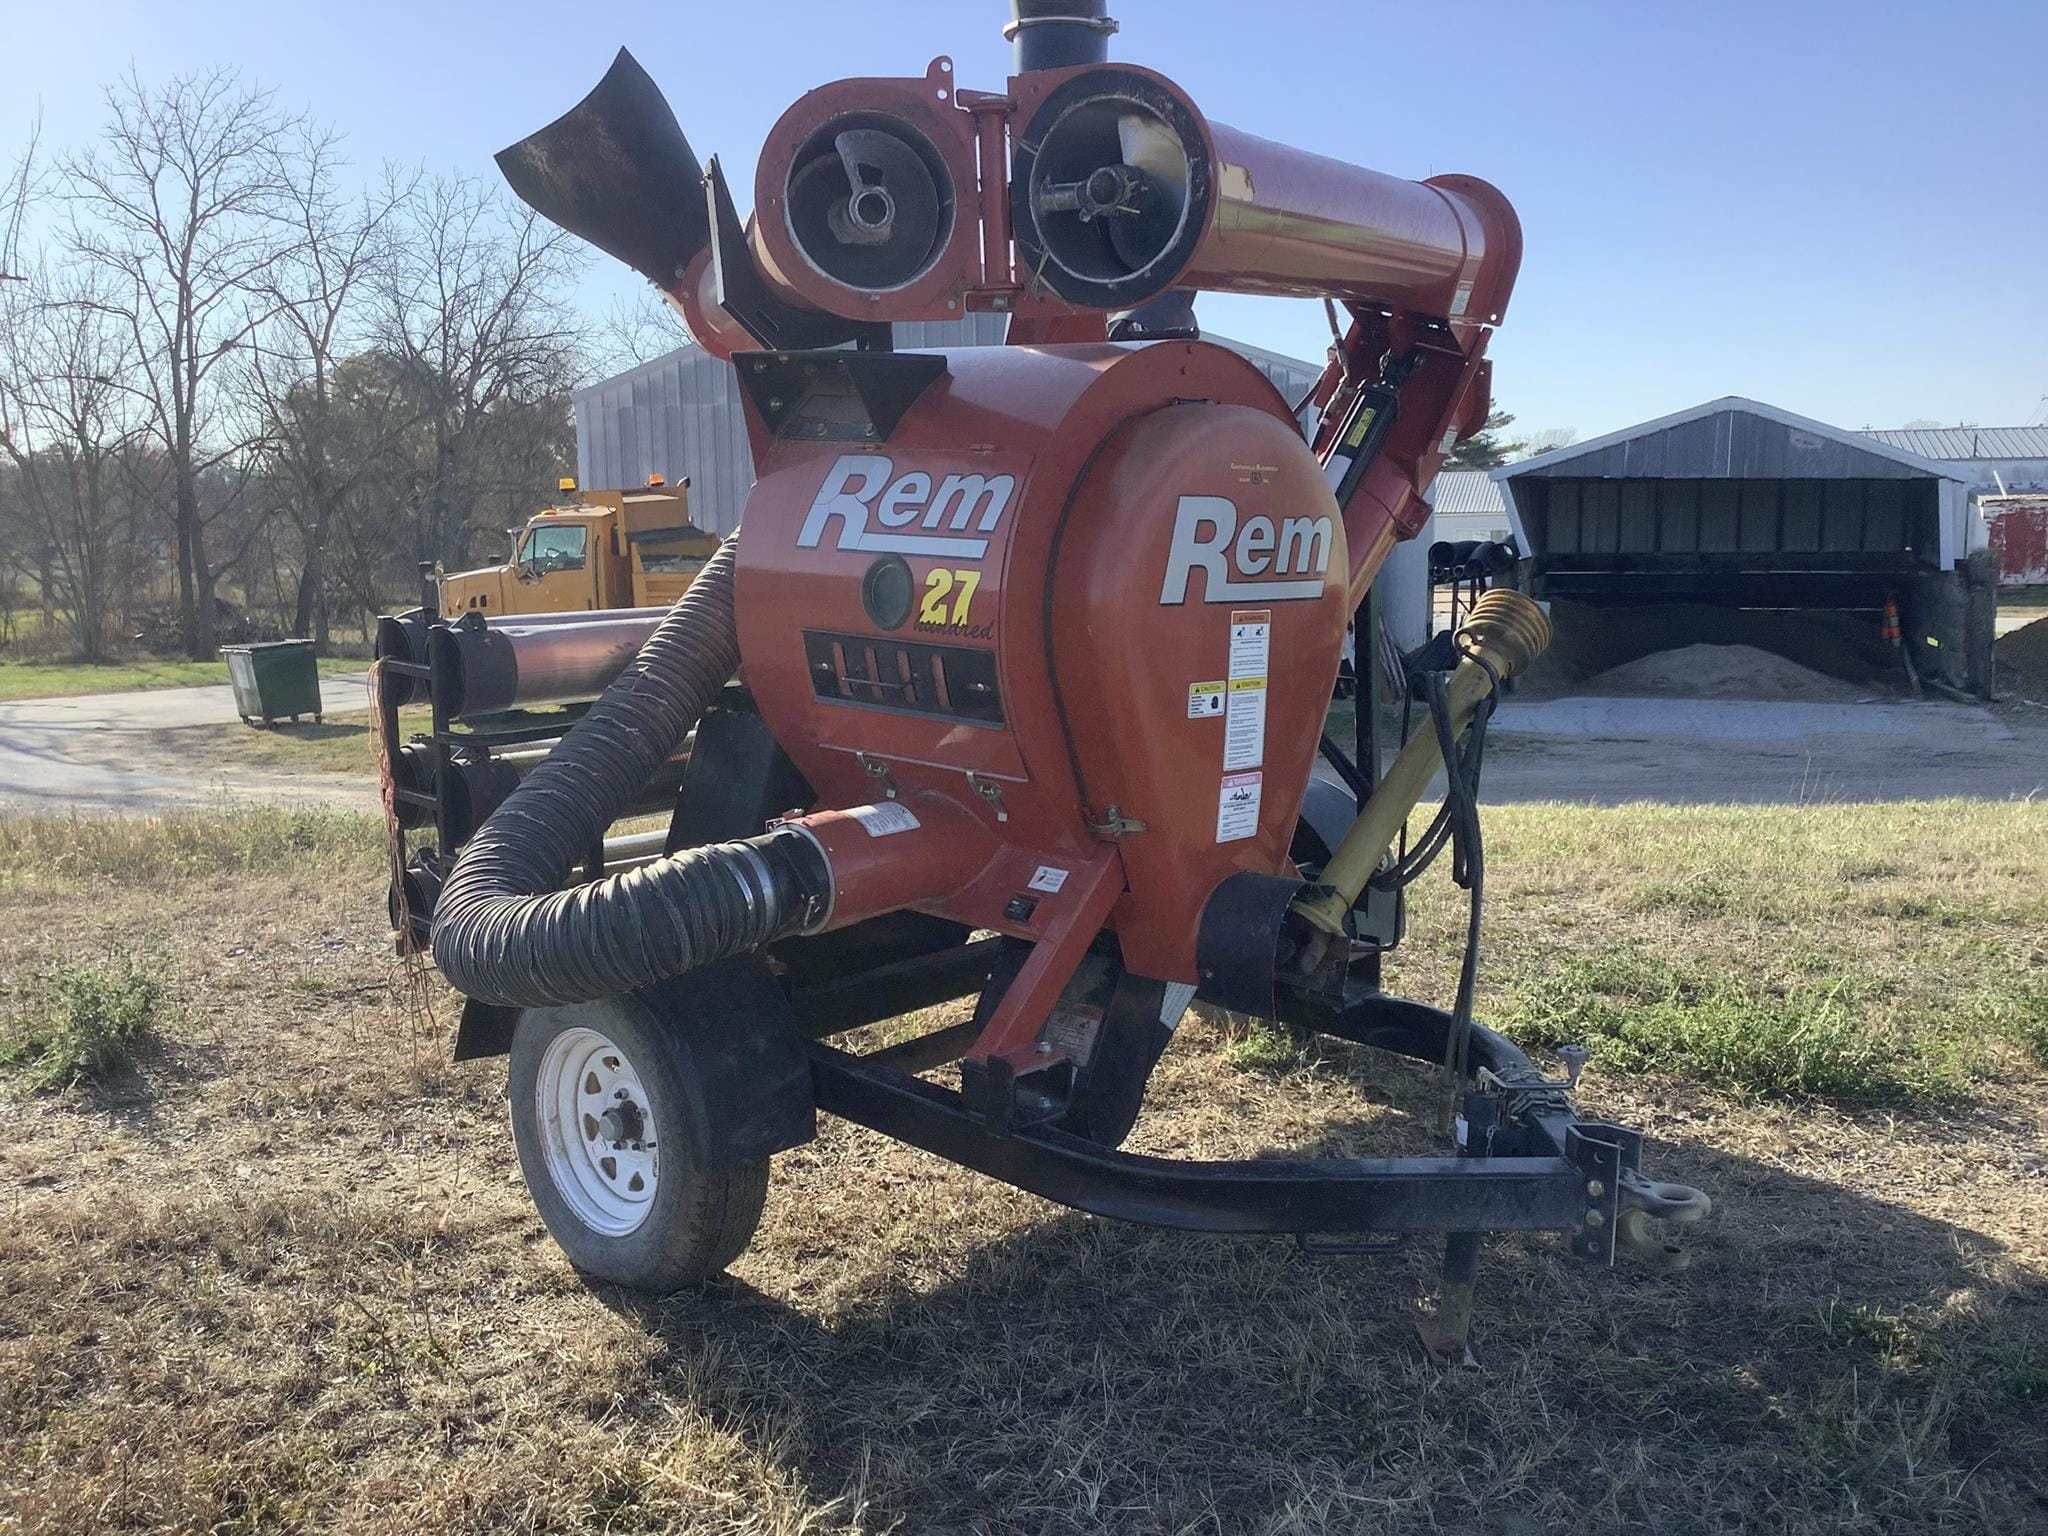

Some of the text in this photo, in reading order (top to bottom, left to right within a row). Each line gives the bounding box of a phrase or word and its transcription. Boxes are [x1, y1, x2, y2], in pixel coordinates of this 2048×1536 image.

[796, 454, 1016, 558] Rem
[1159, 495, 1333, 604] Rem
[919, 567, 982, 626] 27
